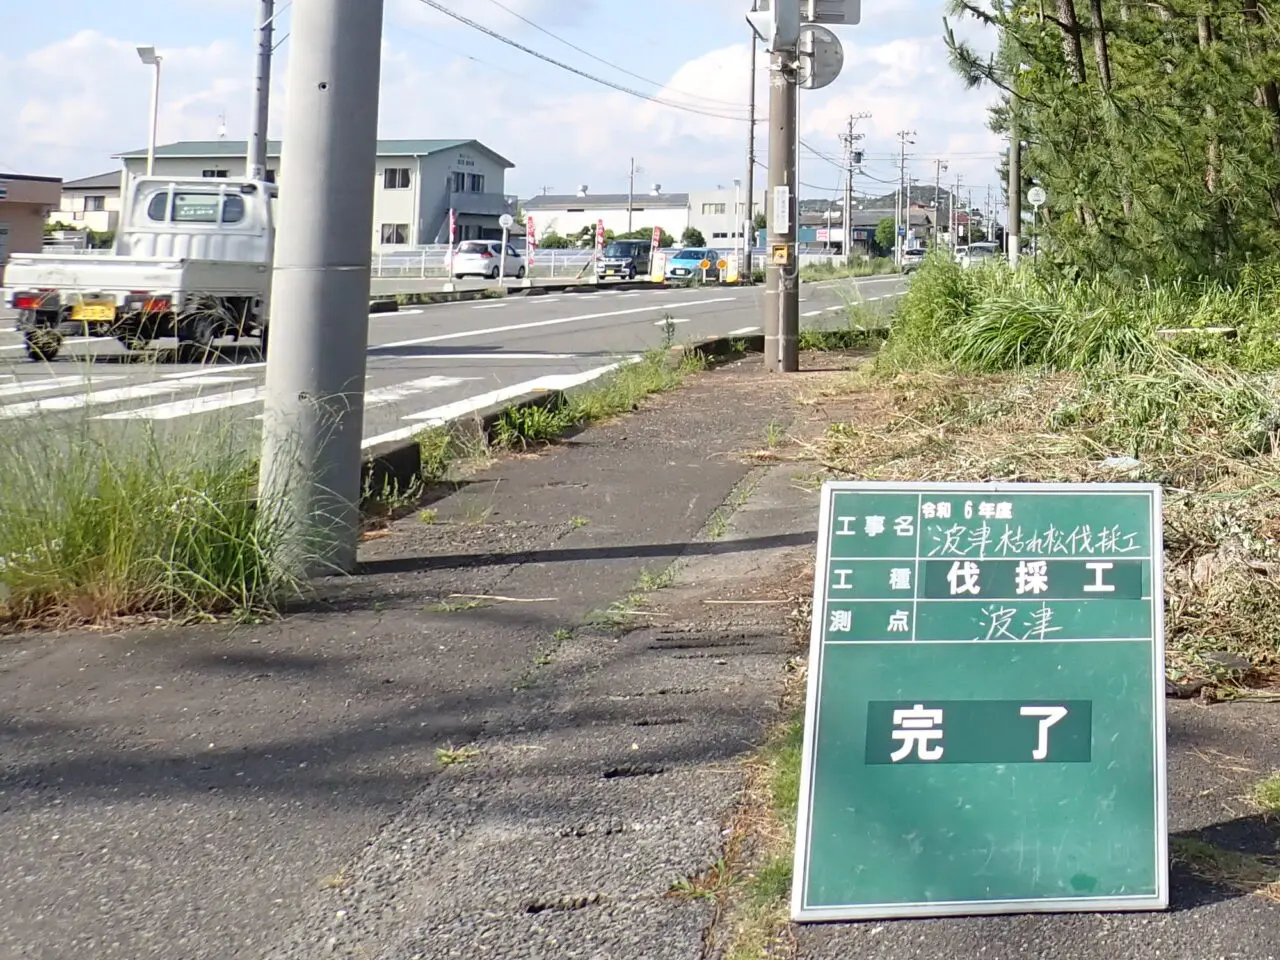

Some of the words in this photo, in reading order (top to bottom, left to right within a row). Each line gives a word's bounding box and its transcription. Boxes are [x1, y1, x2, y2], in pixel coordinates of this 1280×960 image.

[835, 515, 914, 537] 工事名
[832, 567, 911, 590] 工種
[946, 560, 1115, 595] 伐採工
[829, 609, 909, 632] 測点
[973, 600, 1063, 641] 波津
[890, 704, 1068, 762] 完了
